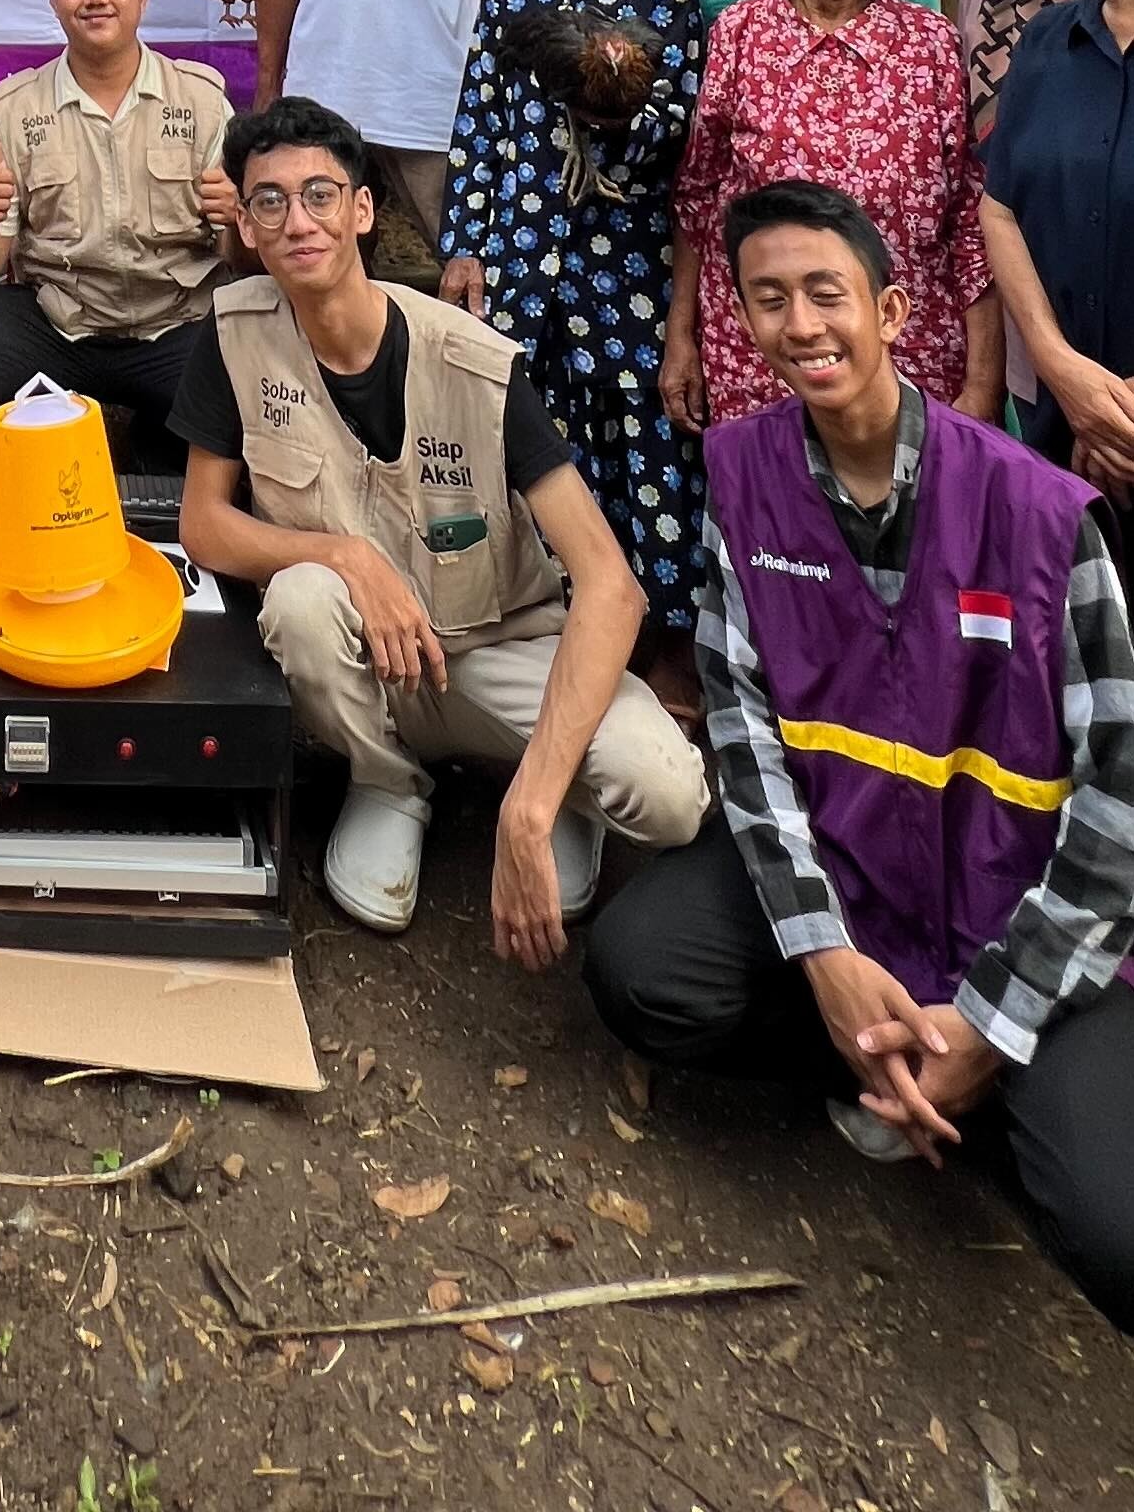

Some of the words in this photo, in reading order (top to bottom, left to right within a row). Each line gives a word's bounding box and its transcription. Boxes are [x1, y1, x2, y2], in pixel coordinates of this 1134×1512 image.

[22, 114, 56, 130] Sobat
[162, 106, 192, 123] Siap
[261, 377, 306, 406] Sobat
[417, 436, 463, 464] Siap
